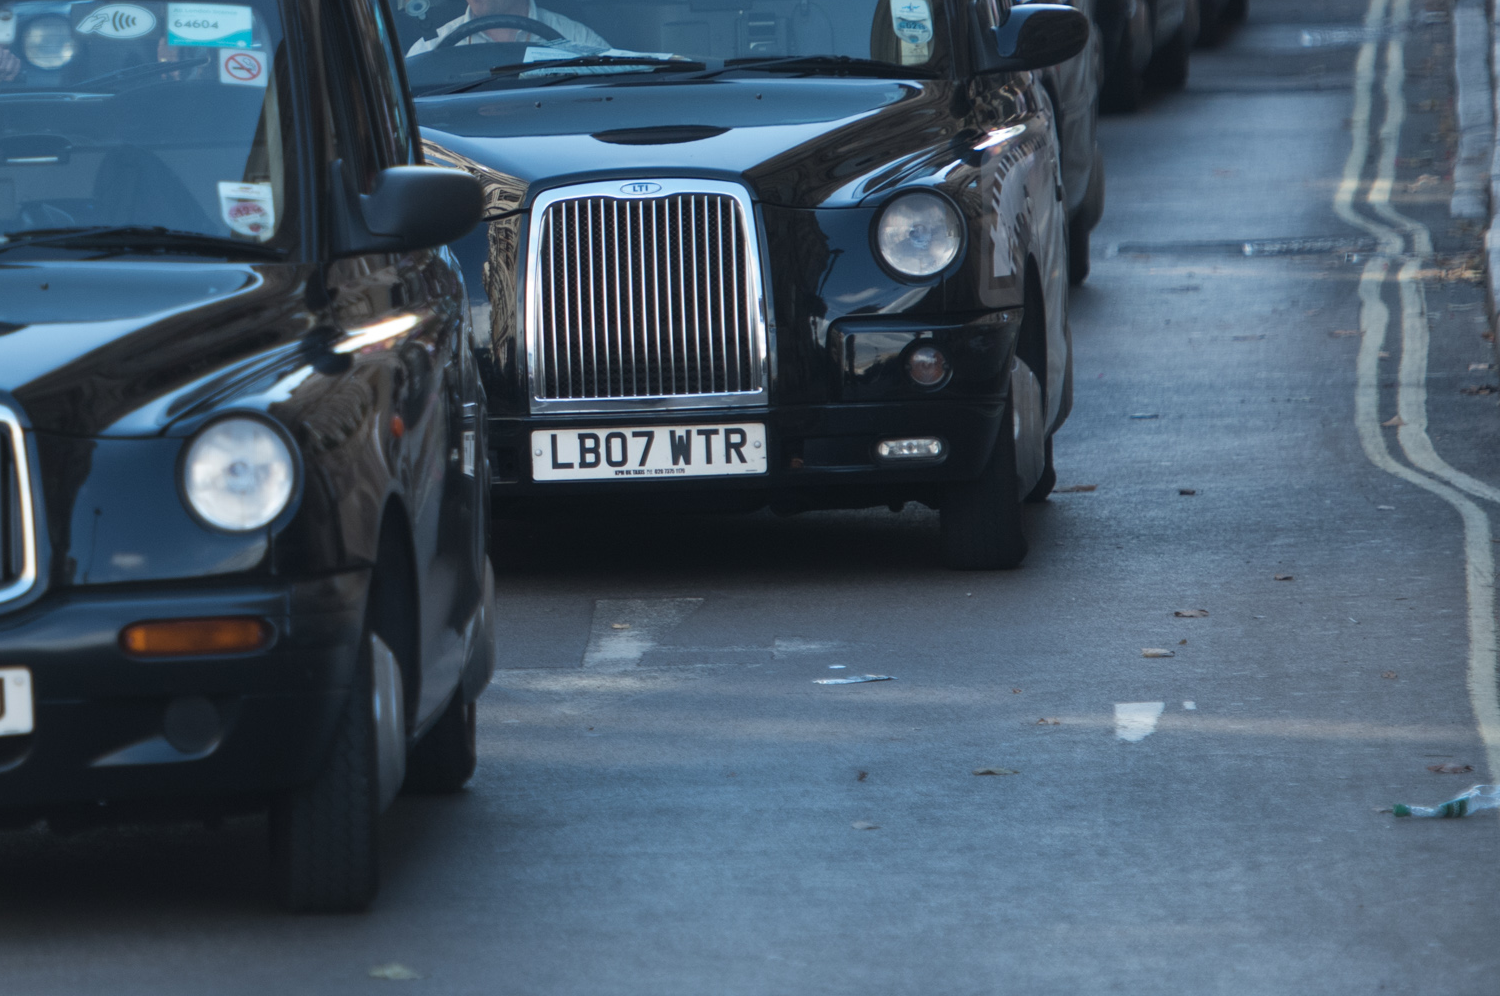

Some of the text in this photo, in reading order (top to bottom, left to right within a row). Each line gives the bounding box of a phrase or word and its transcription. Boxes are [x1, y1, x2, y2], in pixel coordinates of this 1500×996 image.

[174, 19, 219, 29] 64604
[632, 184, 649, 192] LTI
[550, 427, 748, 470] LB07 WTR
